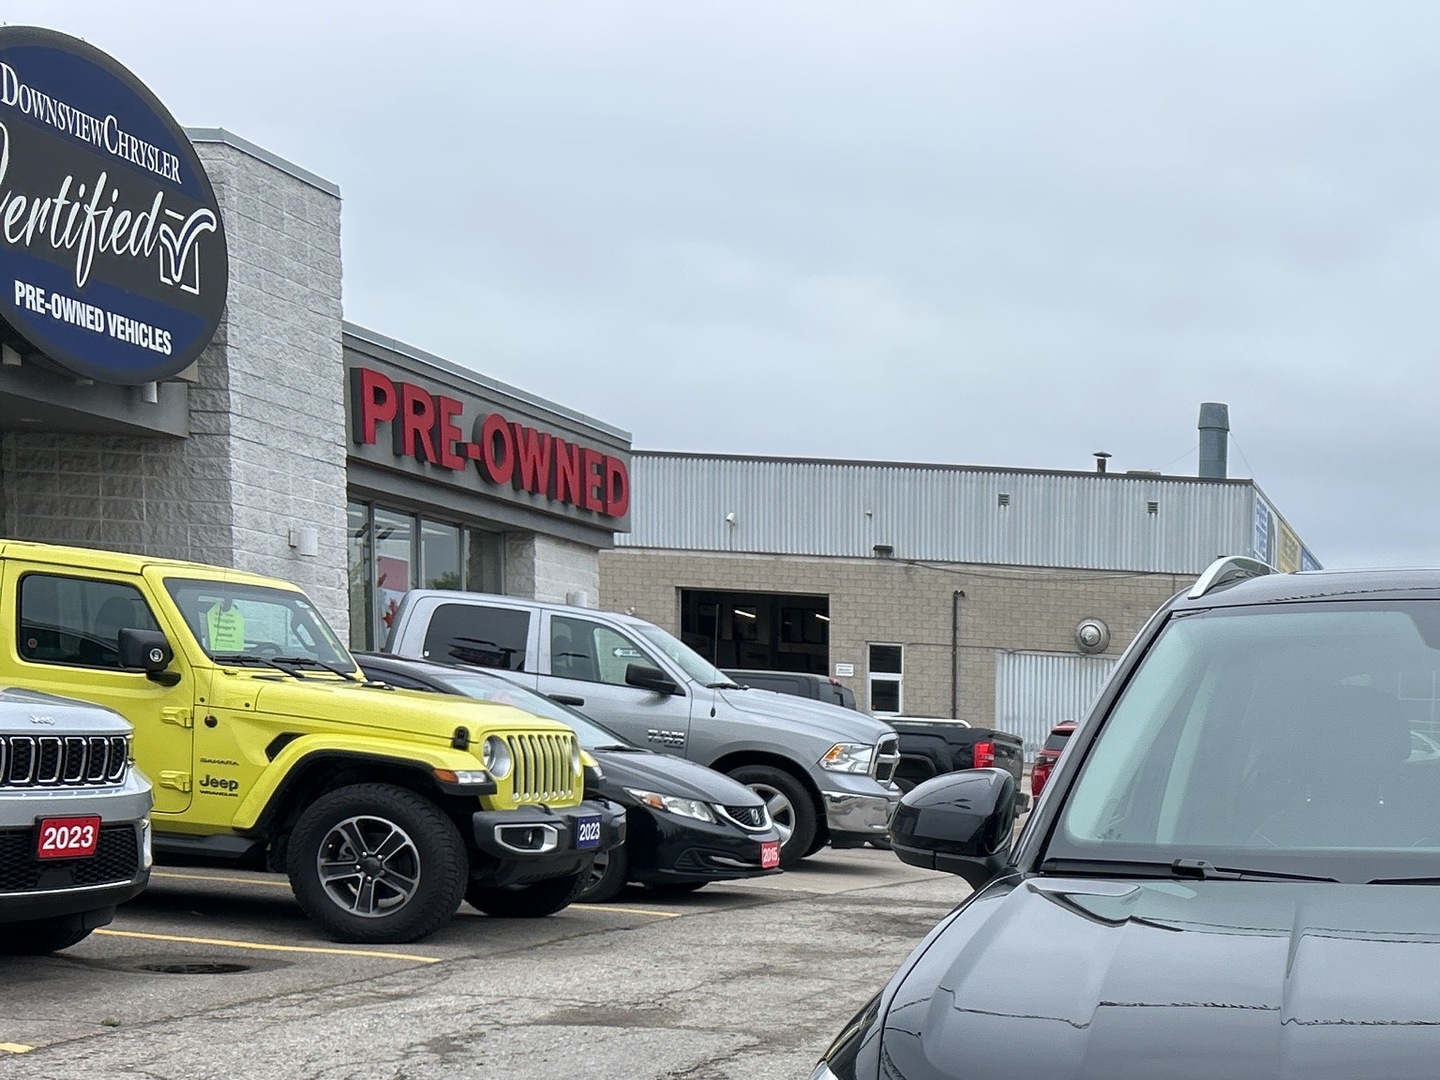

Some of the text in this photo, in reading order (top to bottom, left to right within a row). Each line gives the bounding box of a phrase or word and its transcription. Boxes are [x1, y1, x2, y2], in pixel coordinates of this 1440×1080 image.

[14, 280, 172, 356] PRE-OWNED VEHICLES
[353, 367, 630, 518] PRE-OWNED
[199, 774, 239, 792] Jeep
[42, 825, 94, 850] 2023
[579, 822, 600, 841] 2023
